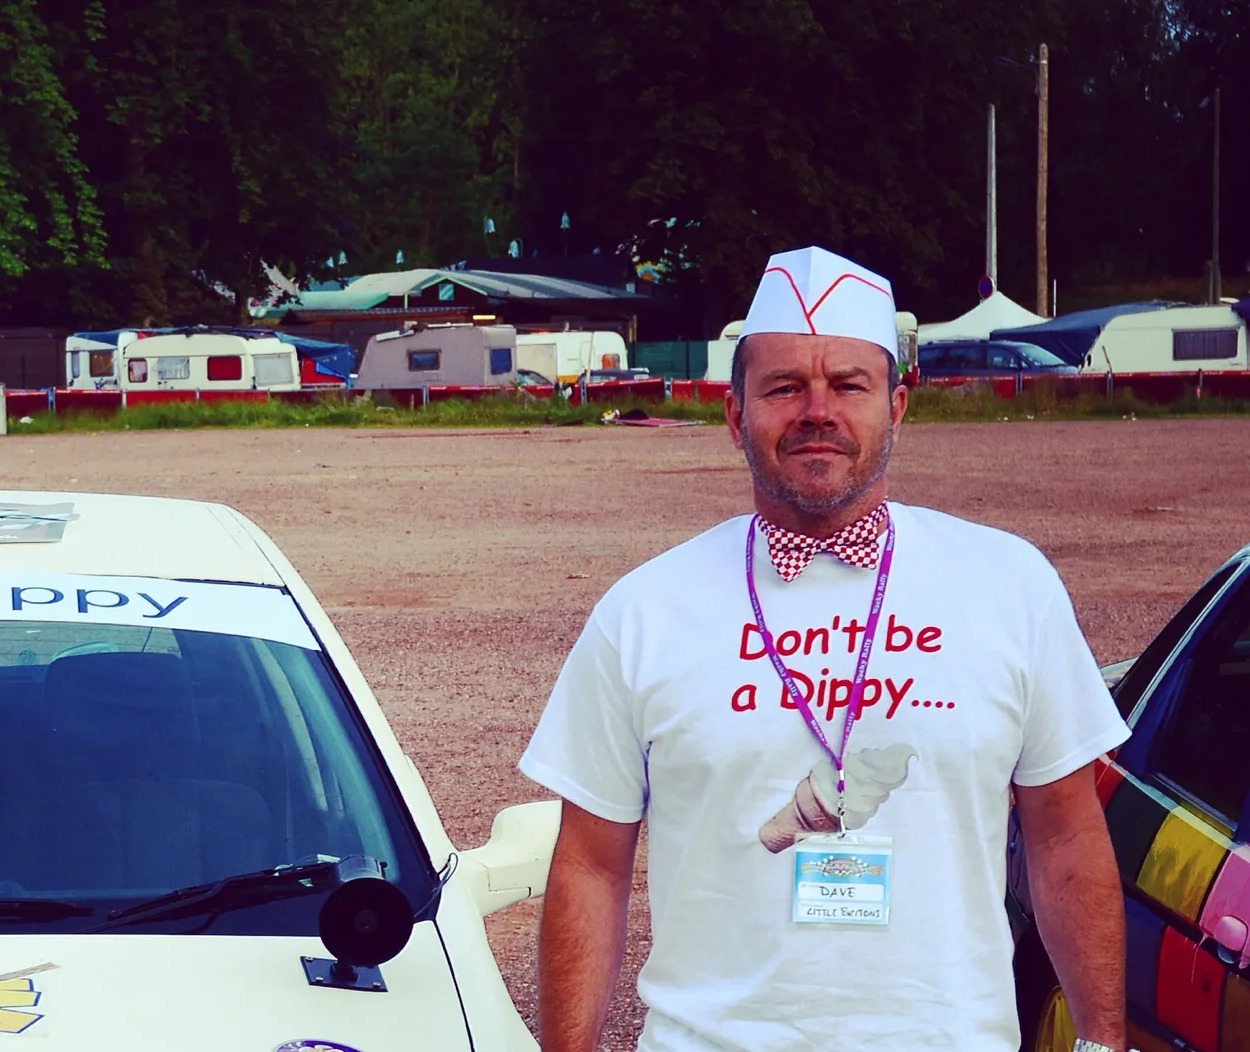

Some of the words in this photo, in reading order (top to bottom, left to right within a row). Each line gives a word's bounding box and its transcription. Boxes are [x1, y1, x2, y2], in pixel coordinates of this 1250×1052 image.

[739, 615, 866, 660] Don't
[885, 614, 942, 652] be
[772, 654, 786, 677] Wacky
[785, 677, 798, 697] Rally
[855, 659, 867, 684] Wacky
[861, 638, 872, 658] Rally
[731, 683, 757, 712] a
[819, 885, 856, 898] DAVE
[807, 907, 837, 917] LITTLE
